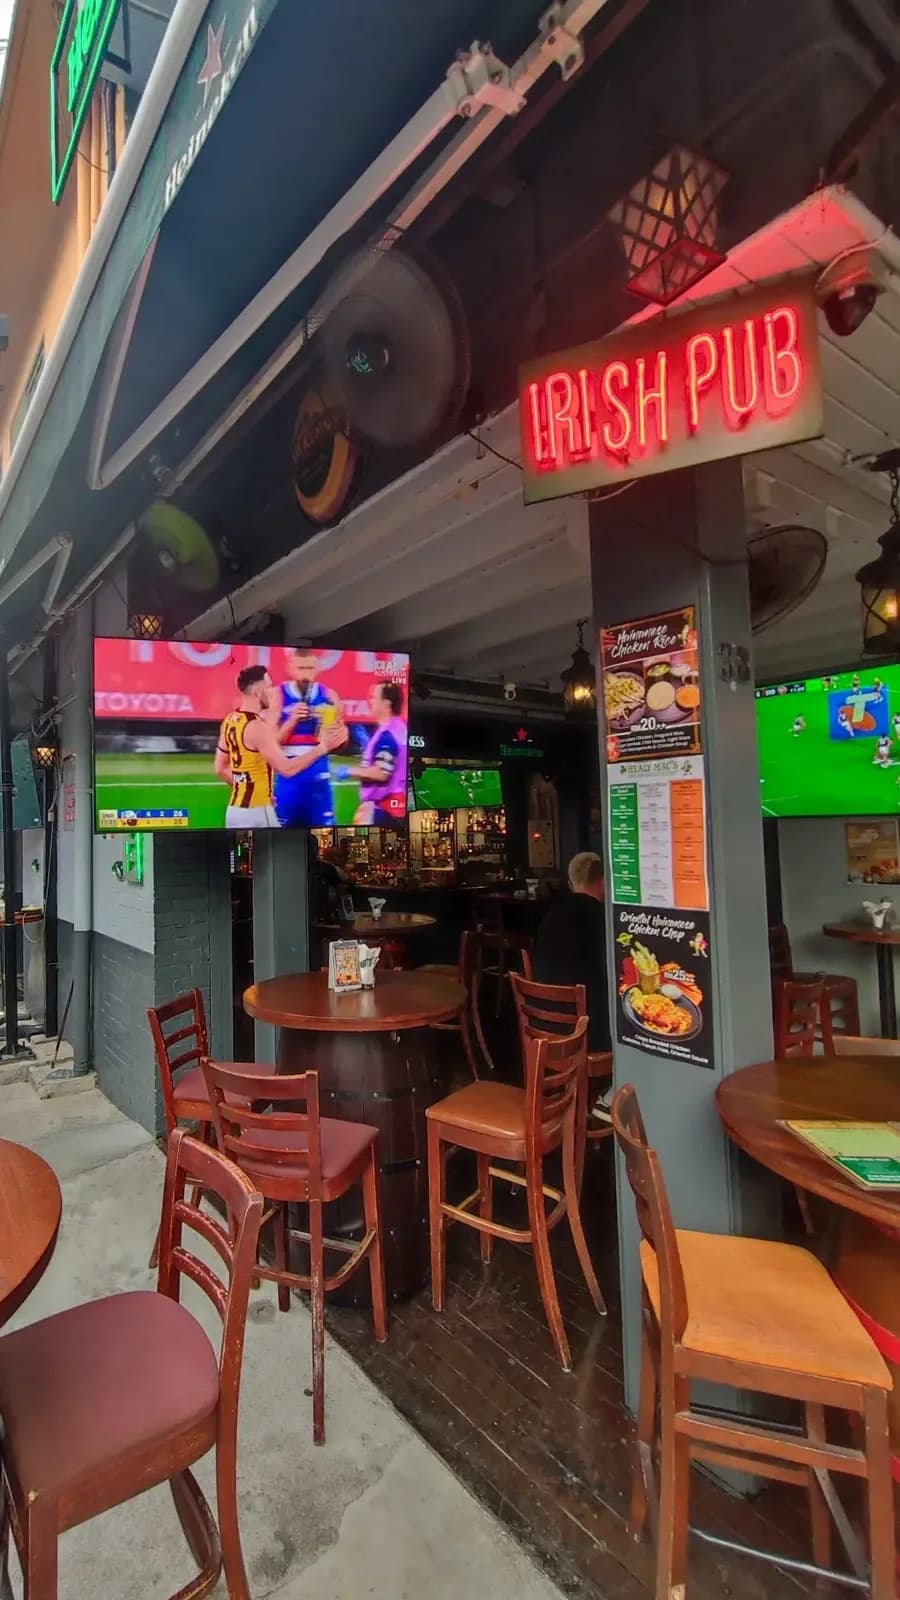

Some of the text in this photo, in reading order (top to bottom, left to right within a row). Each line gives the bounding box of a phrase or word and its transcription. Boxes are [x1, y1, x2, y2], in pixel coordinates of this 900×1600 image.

[529, 307, 801, 463] IRISH PUB
[611, 633, 677, 658] Chicken Rice
[617, 625, 668, 645] Hainanese
[94, 691, 193, 713] TOYOTA
[620, 911, 695, 930] Oriental Hainanese
[628, 922, 686, 943] Chicken Chop
